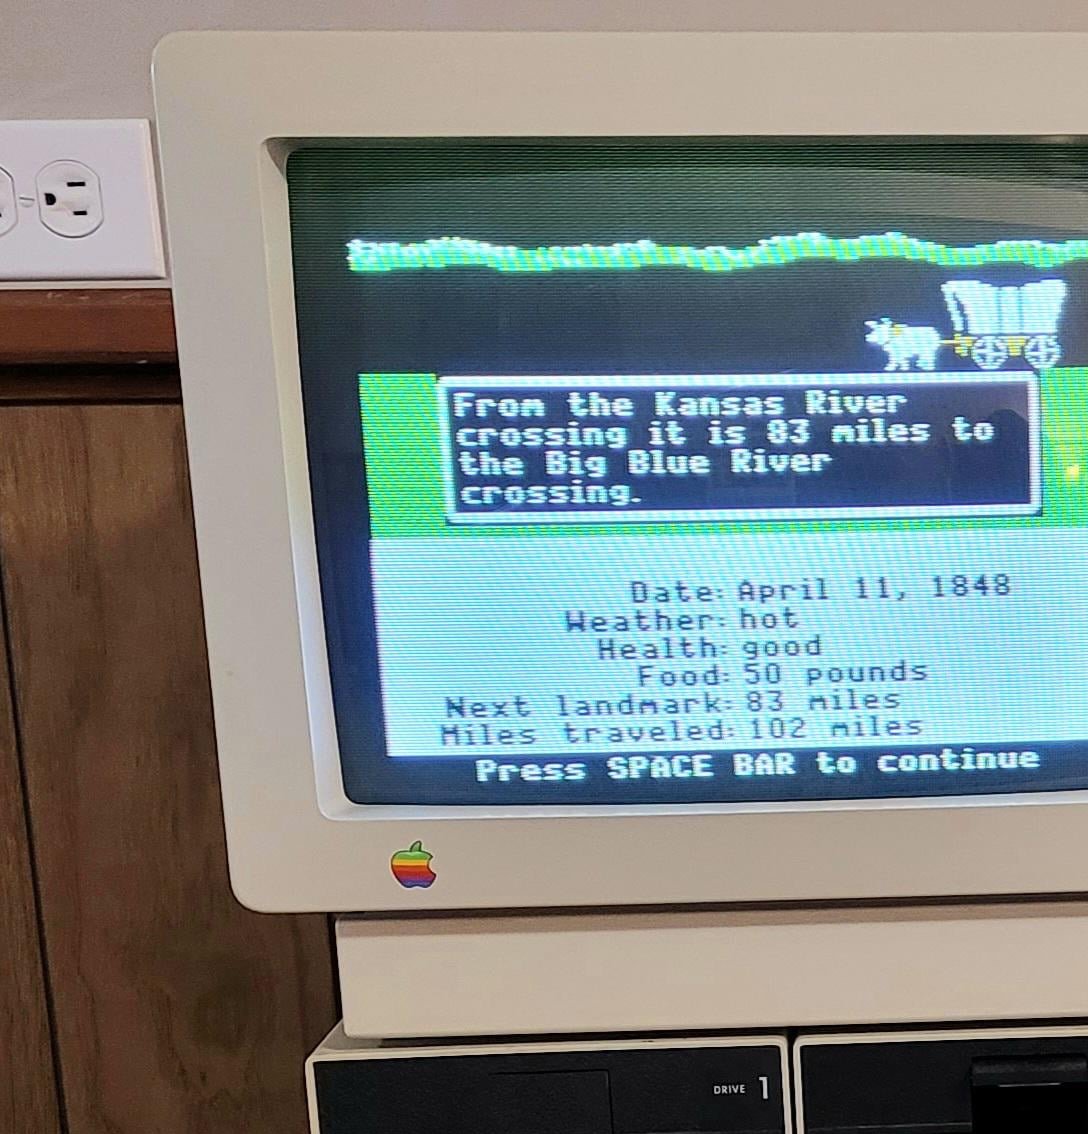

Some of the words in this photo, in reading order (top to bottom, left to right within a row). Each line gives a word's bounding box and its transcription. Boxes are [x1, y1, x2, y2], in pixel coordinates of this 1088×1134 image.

[453, 393, 545, 418] From
[567, 392, 633, 417] the
[655, 392, 784, 417] Kansas
[806, 391, 908, 414] River
[456, 422, 627, 450] crossing
[649, 421, 686, 445] it
[708, 421, 747, 444] is
[766, 421, 811, 443] 83
[832, 418, 931, 443] miles
[954, 419, 994, 442] to
[460, 452, 525, 476] the
[545, 451, 608, 479] Big
[630, 450, 712, 476] Blue
[732, 449, 833, 473] River
[461, 480, 643, 509] crossing.
[631, 581, 726, 604] Date:
[737, 578, 831, 604] April
[857, 578, 907, 603] 11,
[932, 574, 1011, 598] 1848
[565, 609, 727, 633] Weather:
[740, 607, 800, 630] hot
[598, 637, 729, 660] Health:
[743, 635, 823, 661] good
[638, 664, 731, 688] Food:
[745, 662, 783, 686] 50
[807, 661, 928, 687] pounds
[446, 696, 530, 719] Next
[557, 692, 733, 717] landmark:
[746, 690, 784, 713] 83
[805, 689, 902, 711] miles
[441, 722, 535, 747] Miles
[565, 718, 736, 743] traveled:
[749, 717, 805, 739] 102
[831, 716, 923, 738] miles
[476, 757, 586, 782] Press
[607, 753, 713, 779] SPACE
[735, 752, 796, 776] BAR
[817, 751, 857, 775] to
[877, 747, 1041, 773] continue
[713, 1084, 746, 1096] DRIVE
[759, 1076, 769, 1099] 1
